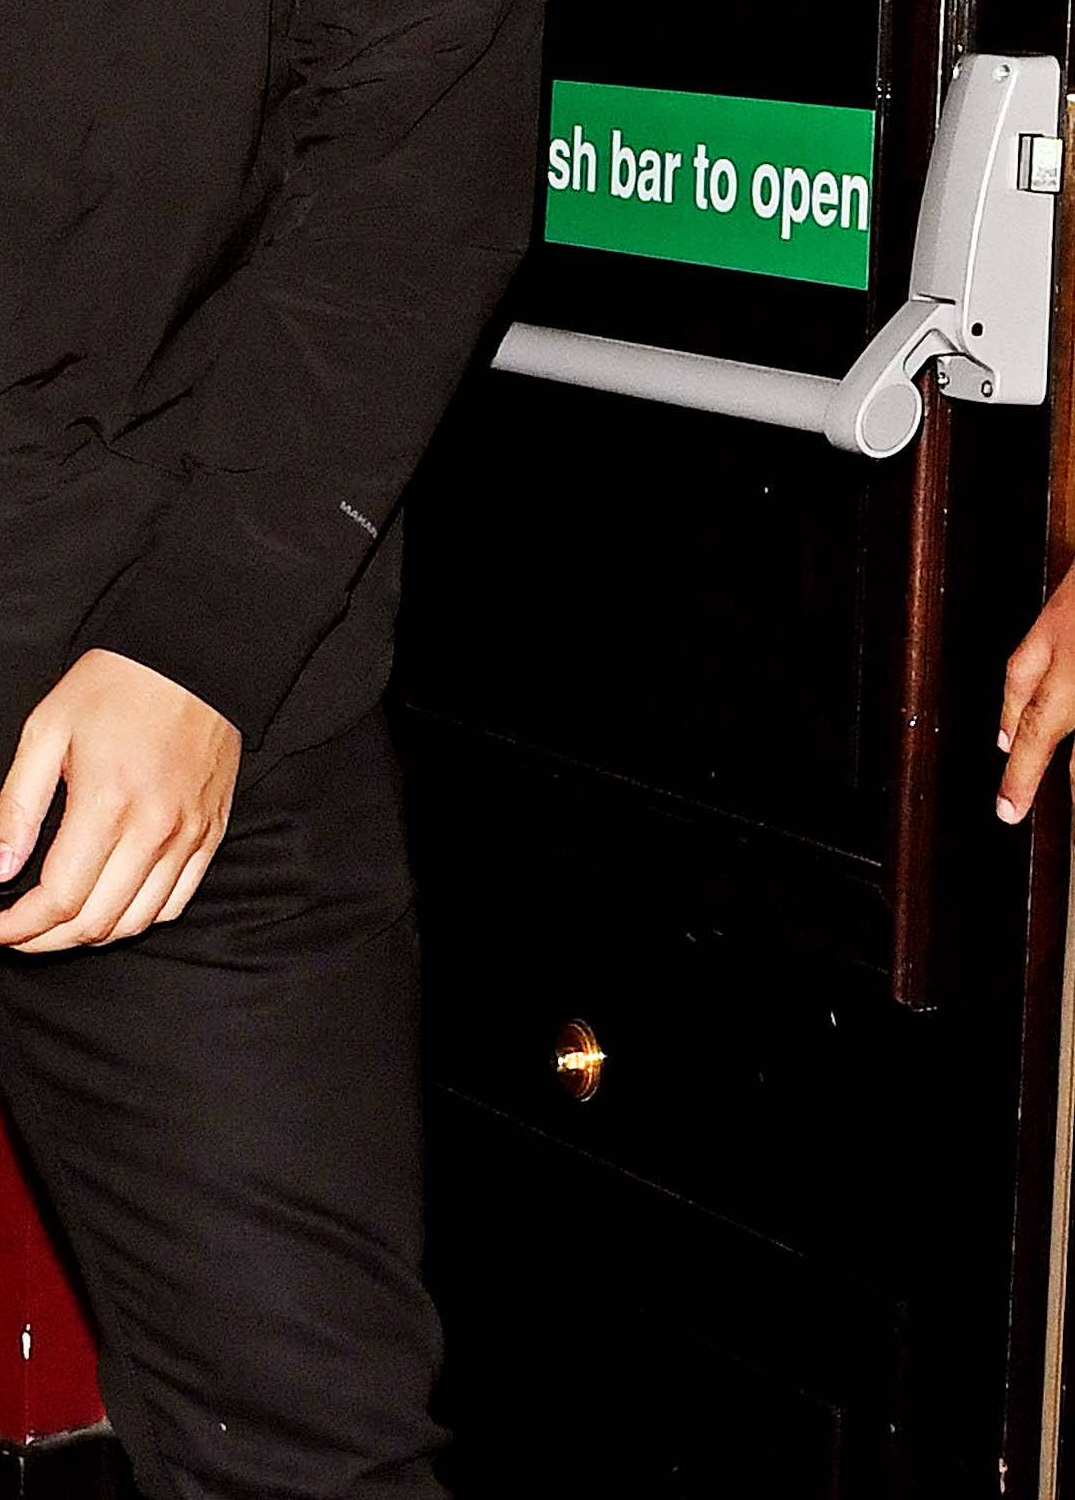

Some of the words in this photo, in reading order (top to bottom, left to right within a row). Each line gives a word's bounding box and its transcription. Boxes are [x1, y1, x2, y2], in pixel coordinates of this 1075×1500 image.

[610, 129, 682, 203] bar
[693, 144, 738, 213] to
[751, 163, 869, 240] open
